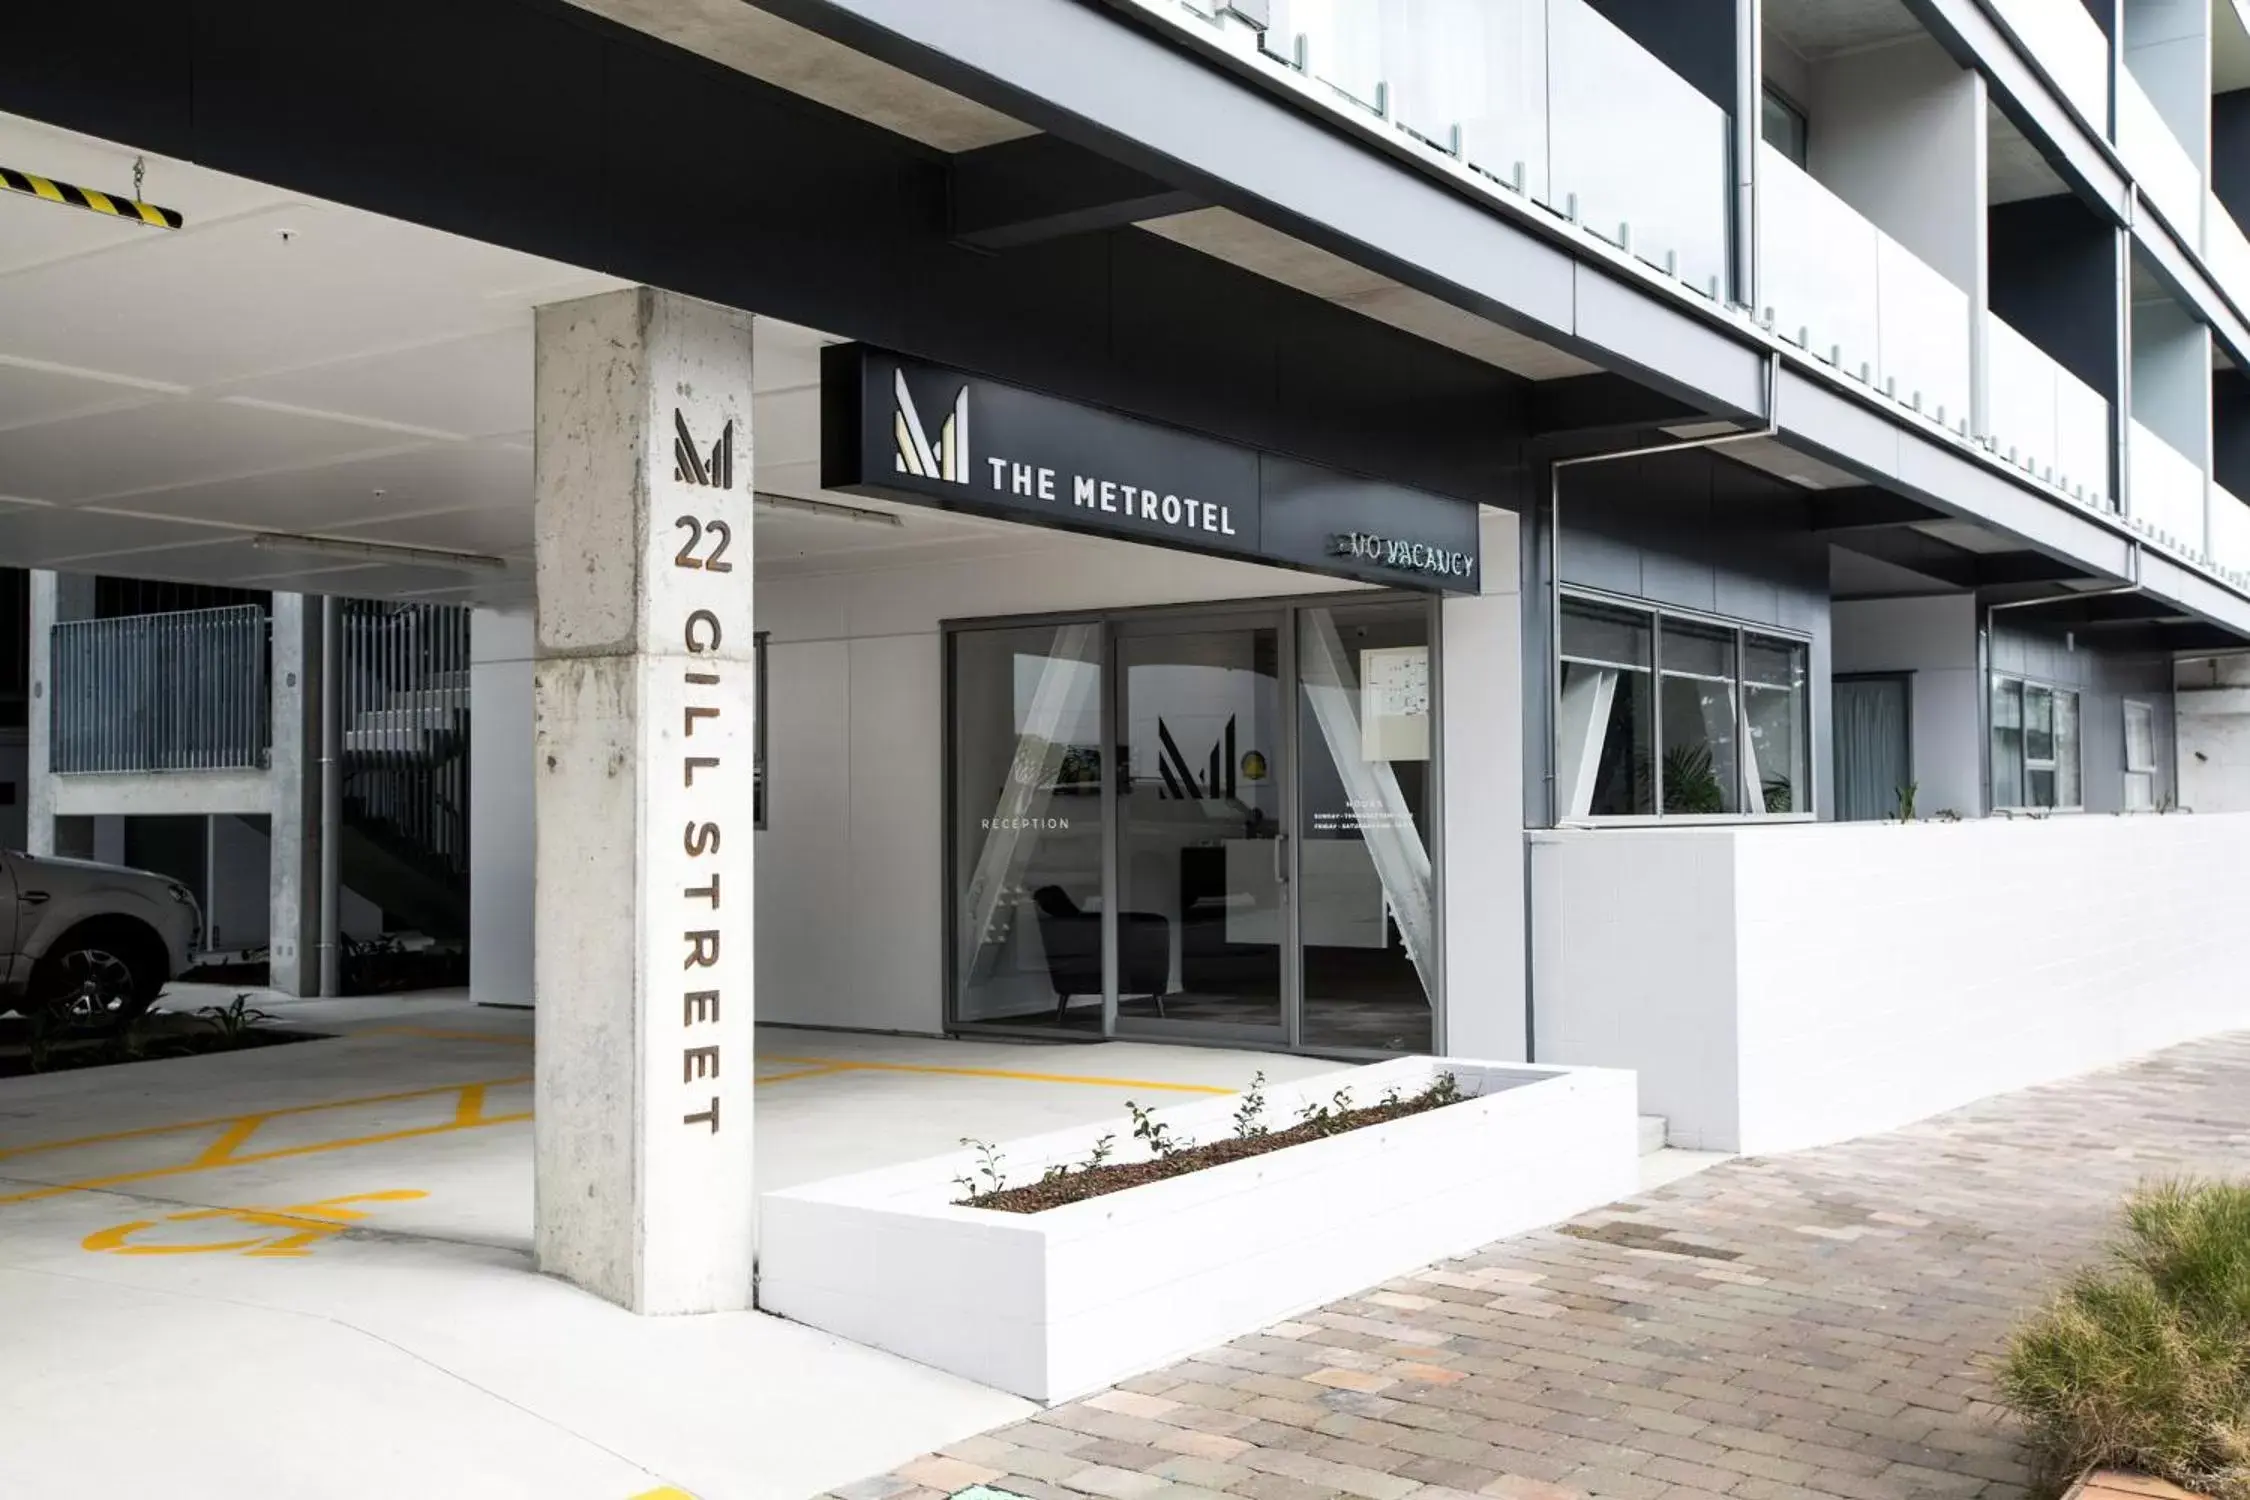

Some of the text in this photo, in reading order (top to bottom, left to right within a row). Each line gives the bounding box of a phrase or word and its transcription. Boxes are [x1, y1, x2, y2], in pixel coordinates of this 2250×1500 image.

[987, 456, 1236, 535] THE METROTEL
[674, 514, 733, 573] 22
[1350, 532, 1474, 577] NO VACANCY
[981, 818, 1069, 830] RECEPTION
[683, 609, 722, 1135] GILL STREET
